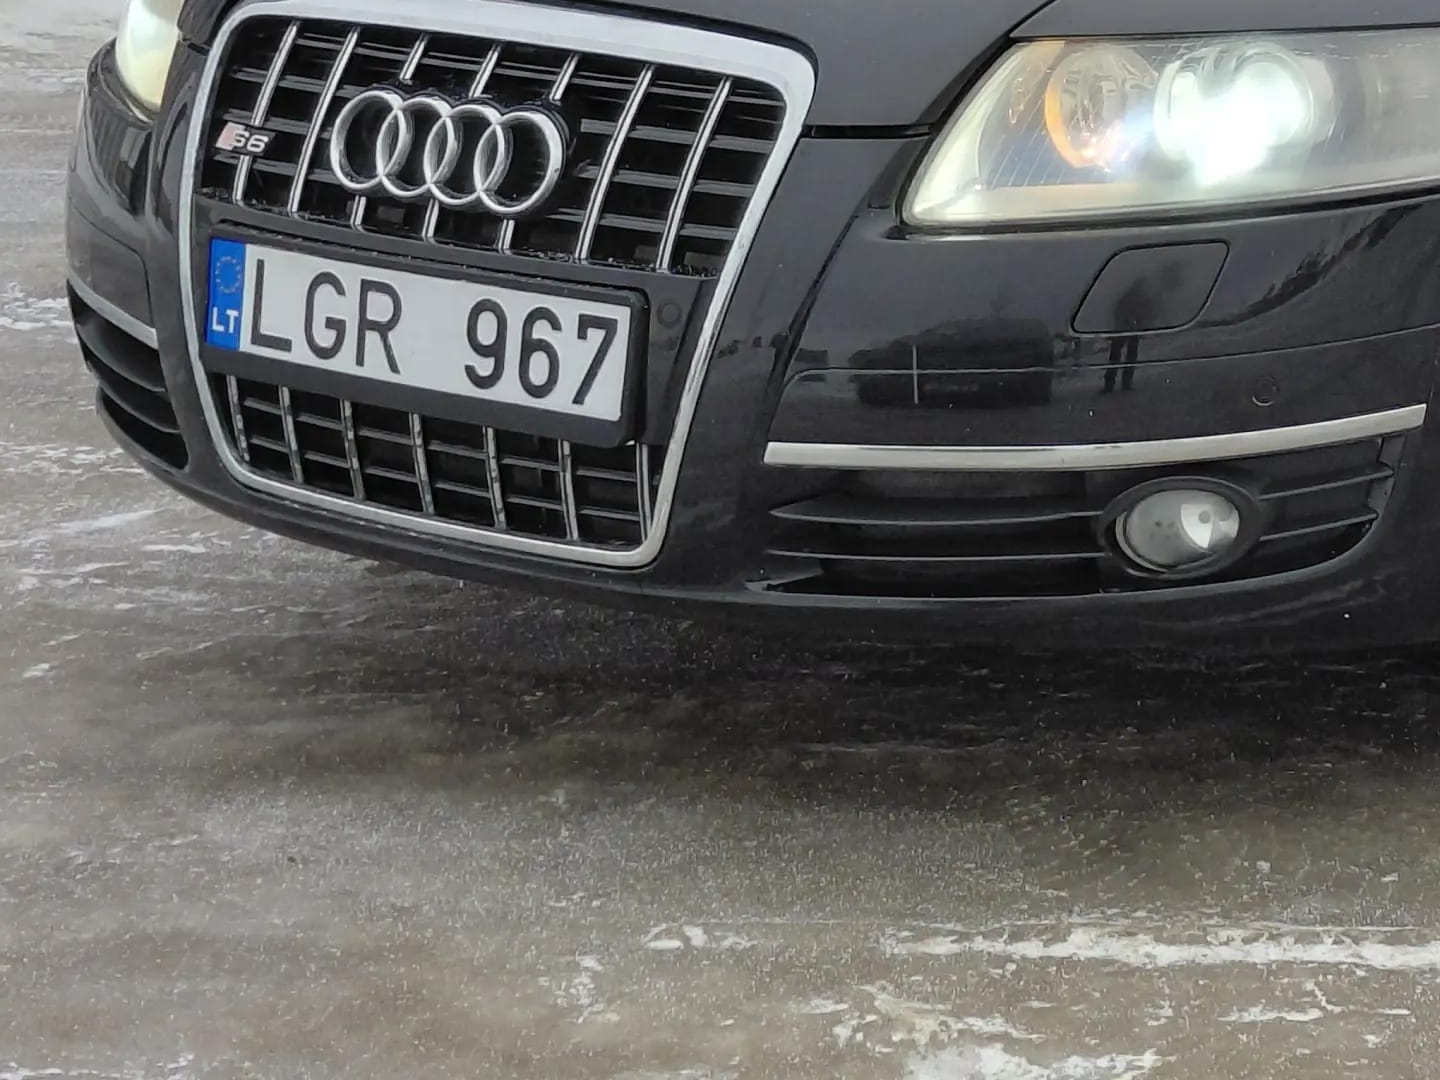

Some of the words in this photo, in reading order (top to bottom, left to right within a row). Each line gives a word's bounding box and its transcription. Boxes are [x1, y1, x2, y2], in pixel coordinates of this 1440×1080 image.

[231, 129, 270, 153] S6
[212, 306, 240, 334] LT
[249, 258, 403, 374] LGR
[463, 297, 619, 406] 967
